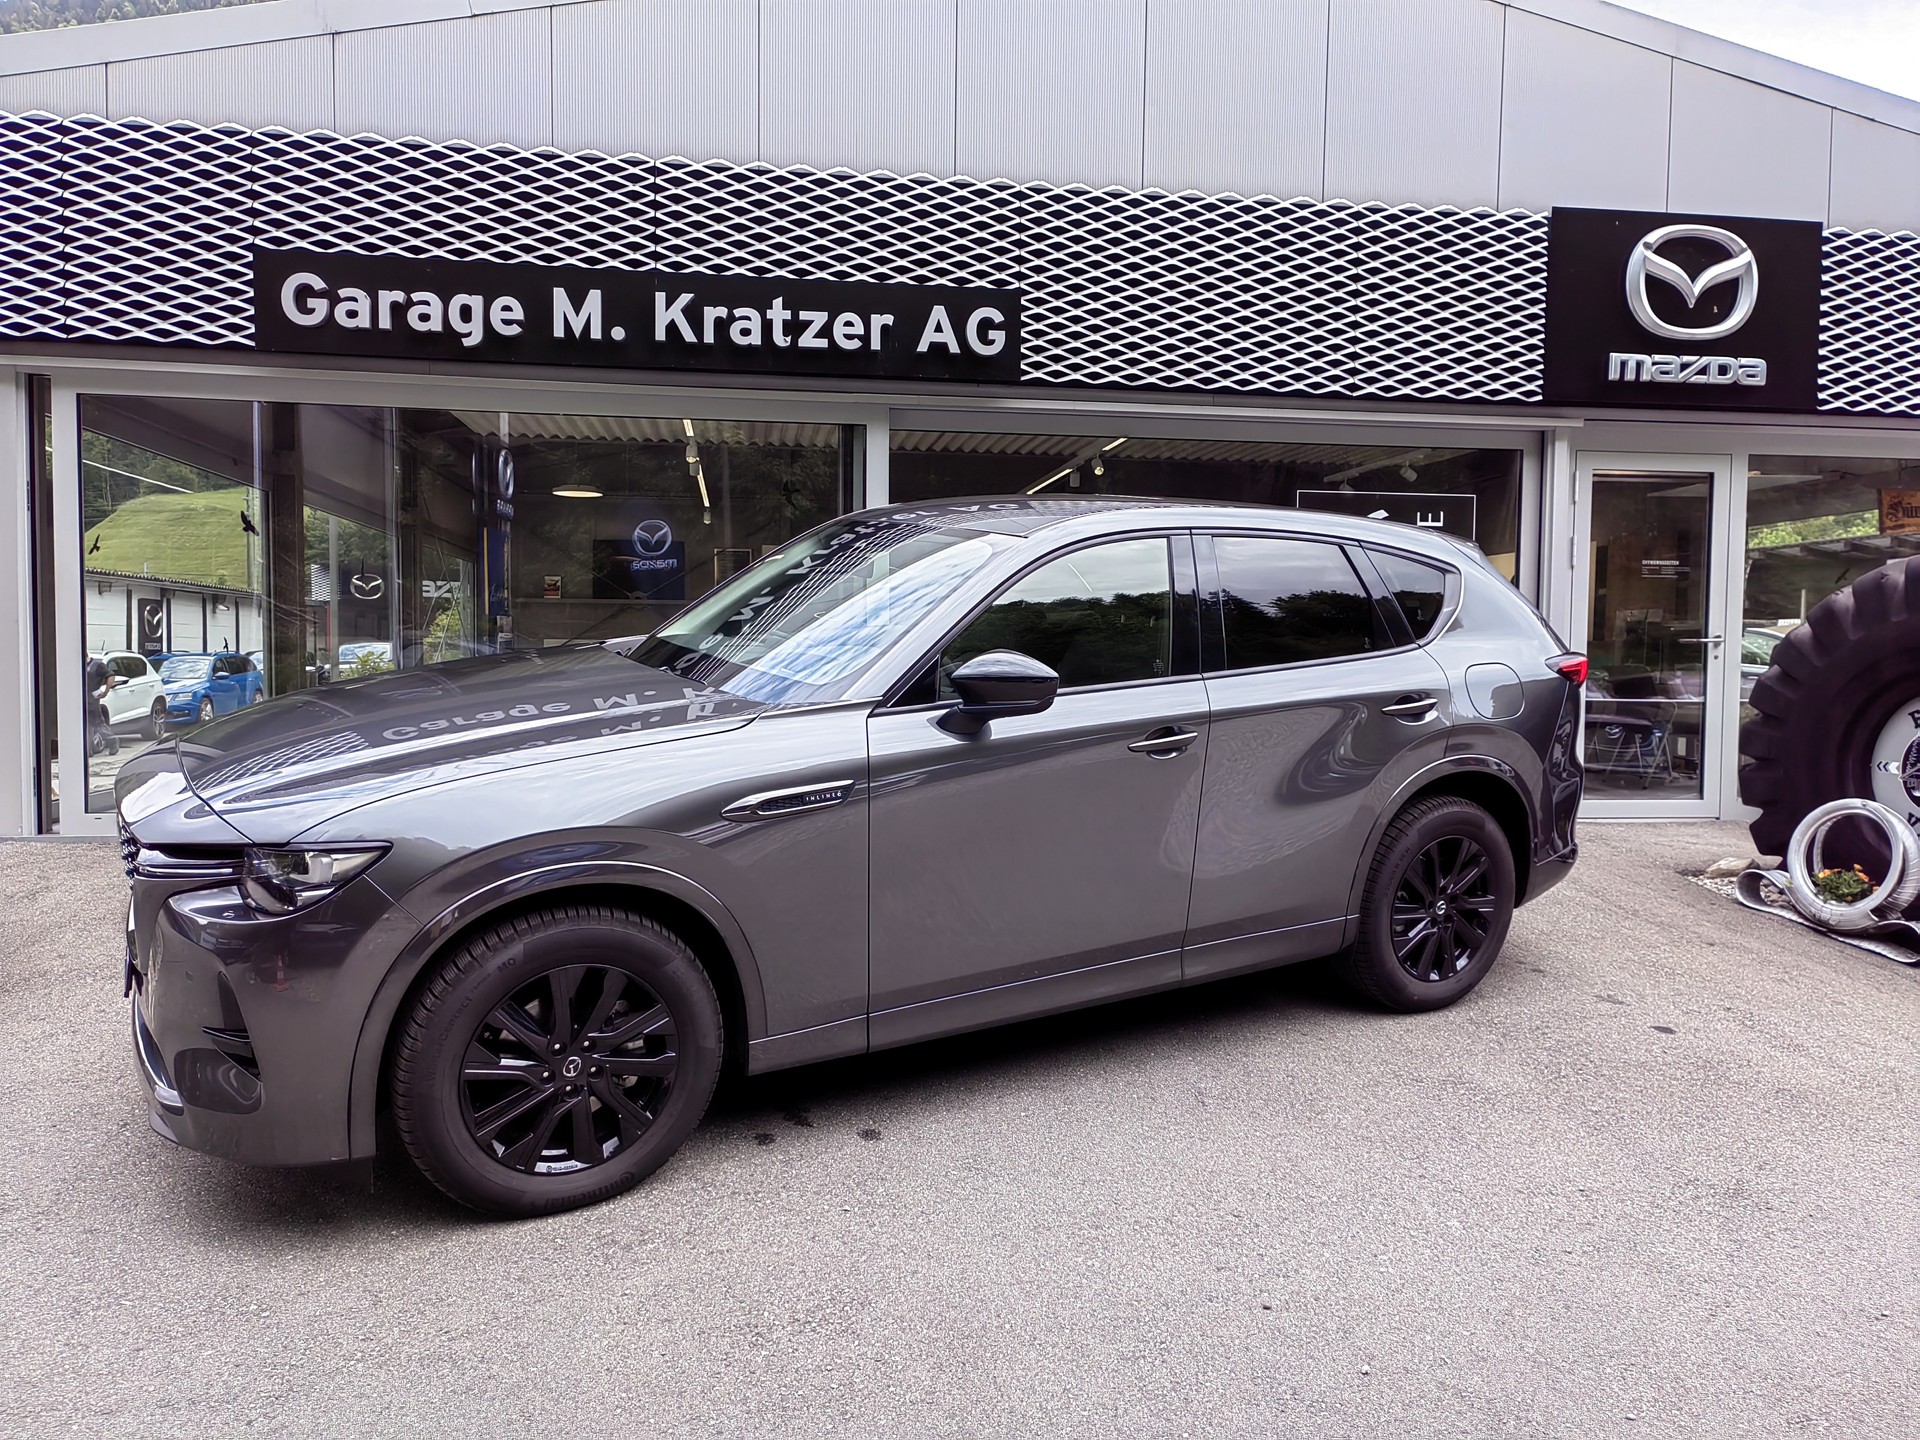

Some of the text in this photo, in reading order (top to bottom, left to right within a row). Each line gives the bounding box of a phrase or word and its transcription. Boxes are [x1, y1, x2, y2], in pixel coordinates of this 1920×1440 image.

[280, 272, 1006, 356] Garage M. Kratzer AG
